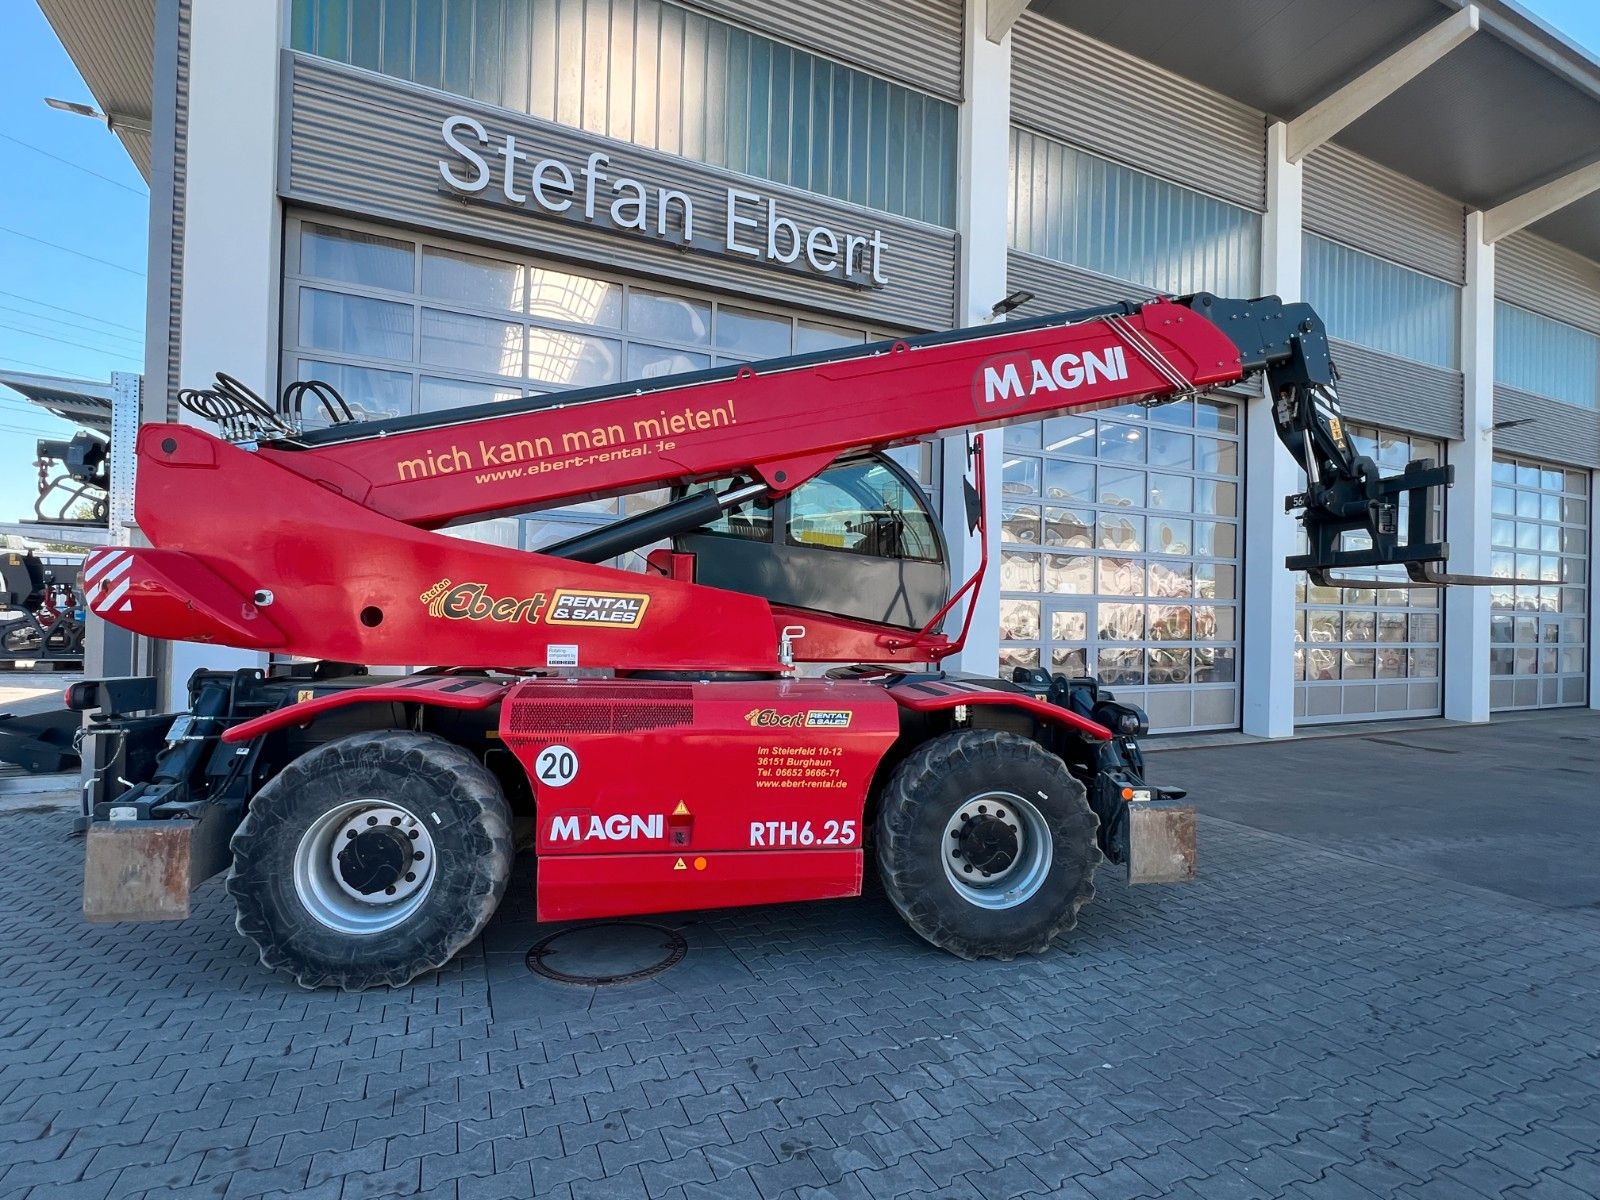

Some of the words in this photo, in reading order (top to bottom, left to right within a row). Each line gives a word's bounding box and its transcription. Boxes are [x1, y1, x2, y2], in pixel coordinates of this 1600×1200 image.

[439, 115, 694, 243] Stefan
[725, 188, 889, 288] Ebert
[984, 346, 1128, 403] MAGNI
[397, 445, 472, 481] mich
[479, 437, 553, 468] kann
[562, 424, 626, 452] man
[634, 399, 737, 440] mieten!
[442, 583, 546, 623] Ebert
[558, 596, 639, 611] RENTAL
[553, 608, 569, 619] &
[572, 609, 636, 623] SALES
[756, 709, 805, 727] Ebert
[757, 747, 769, 755] Im
[771, 747, 816, 756] Steierfeld
[818, 747, 843, 756] 10-12
[757, 757, 784, 766] 36151
[786, 757, 832, 768] Burghaun
[542, 752, 574, 779] 20
[757, 768, 773, 777] Tel.
[775, 768, 803, 777] 06652
[805, 768, 840, 777] 9666-71
[756, 780, 848, 788] www.ebert-rental.de
[549, 814, 664, 841] MAGNI
[750, 820, 856, 846] RTH6.25
